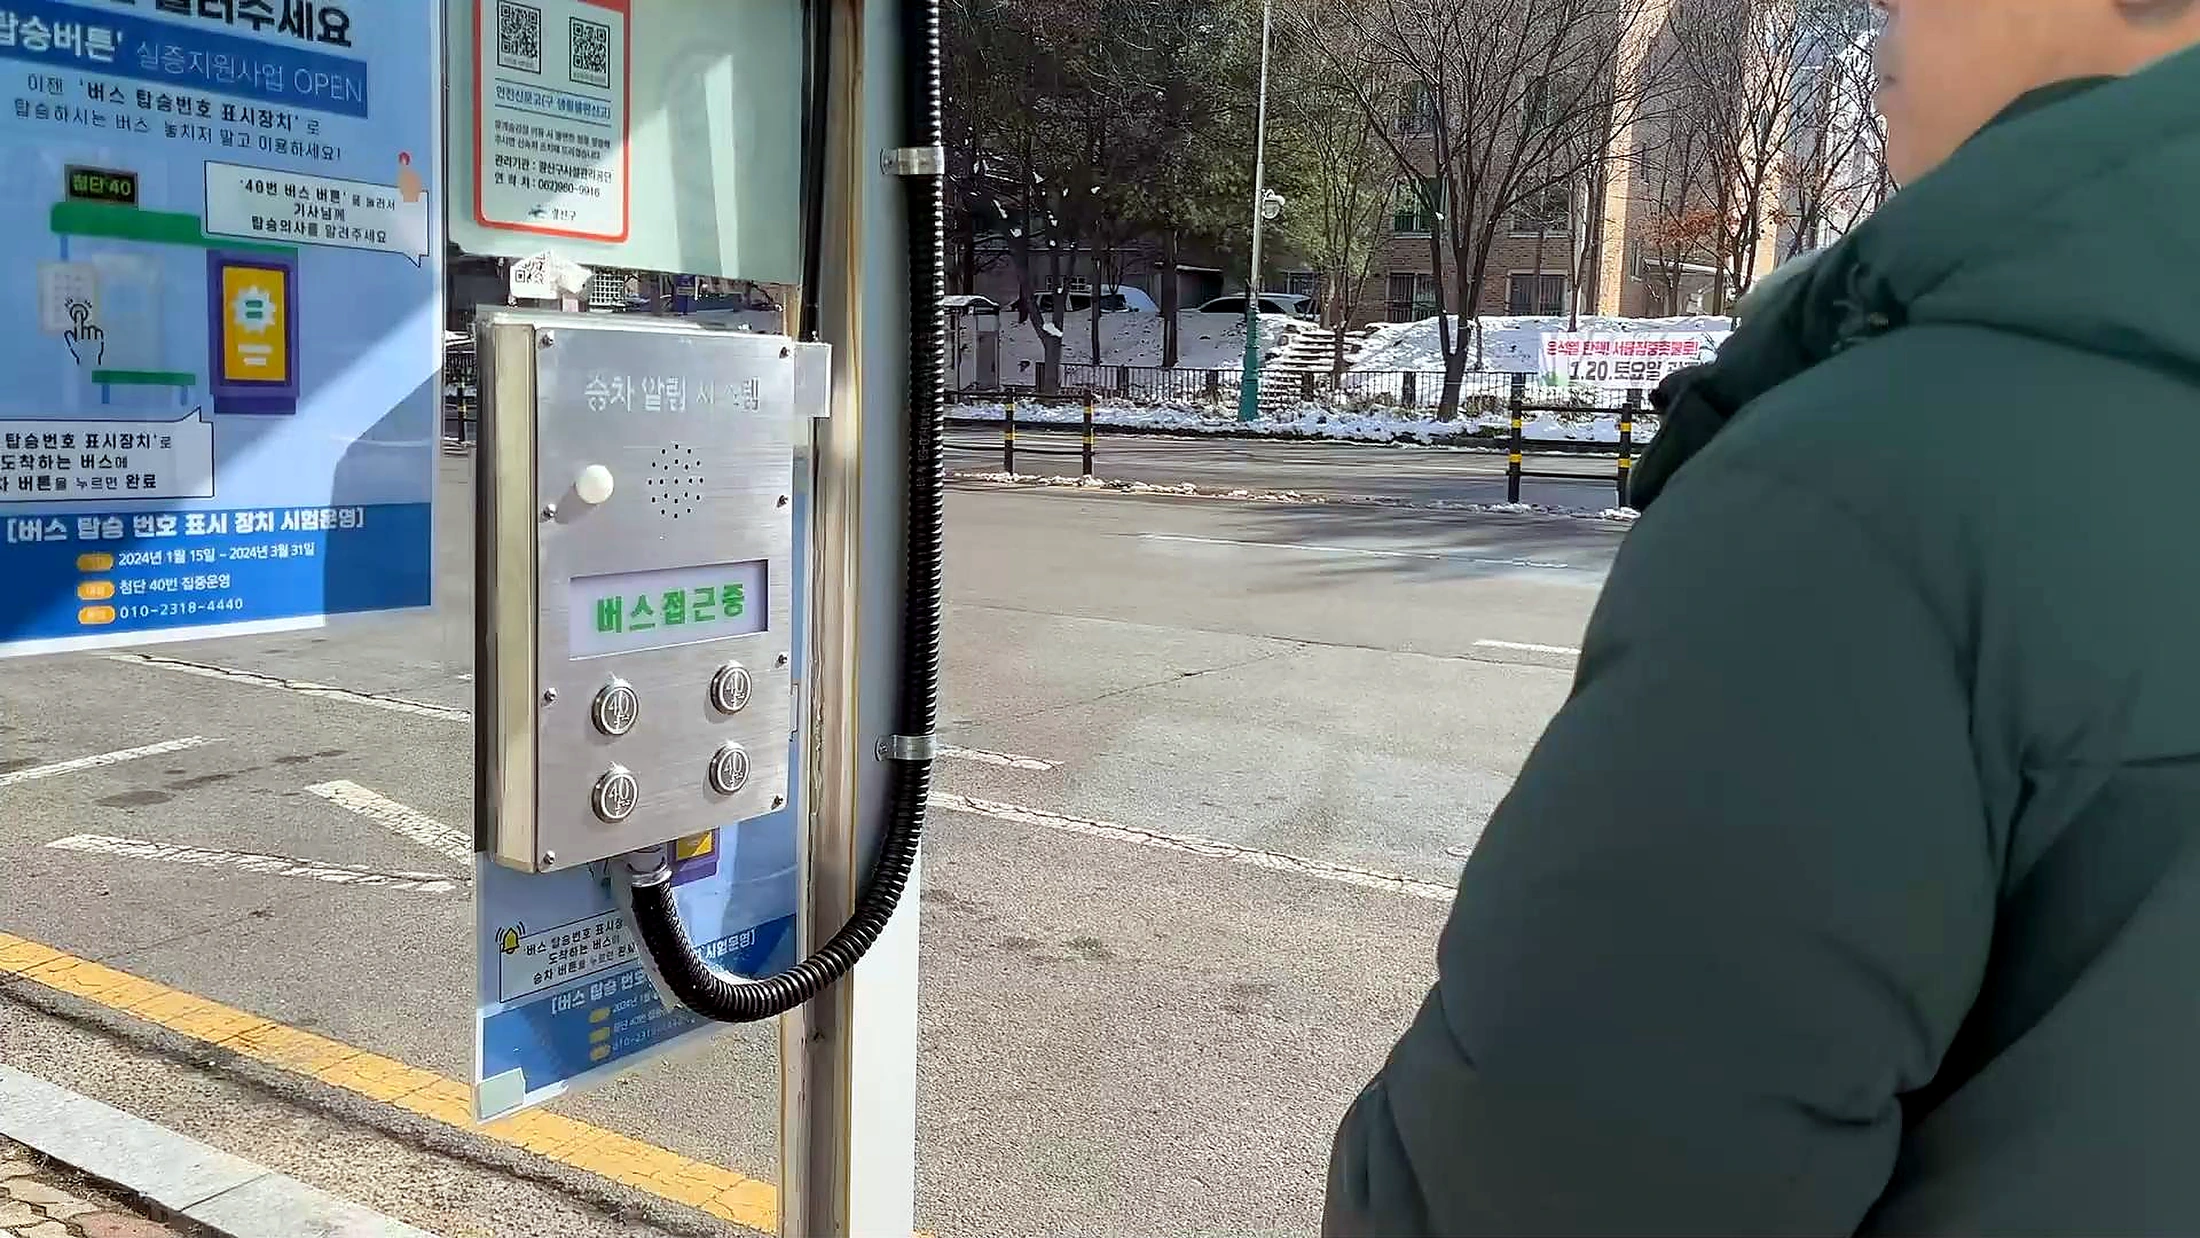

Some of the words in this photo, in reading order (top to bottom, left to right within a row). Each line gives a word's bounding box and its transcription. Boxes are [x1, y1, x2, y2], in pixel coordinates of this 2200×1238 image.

[137, 41, 284, 93] 실증지원사업
[294, 68, 362, 102] OPEN
[28, 73, 65, 96] 이젠
[136, 89, 211, 119] 탑승번호
[306, 119, 321, 136] 로
[15, 98, 106, 127] 탑승하시는
[115, 113, 149, 134] 버스
[220, 128, 251, 148] 말고
[258, 135, 341, 161] 이용하세요!
[109, 179, 132, 196] 40
[284, 183, 310, 201] 버스
[293, 202, 346, 222] 기사님께
[251, 215, 318, 238] 탑승의사를
[325, 223, 387, 244] 알려주세요
[584, 373, 635, 412] 승차
[641, 375, 687, 412] 알림
[5, 432, 76, 450] 탑승번호
[1, 453, 71, 471] 도착하는
[81, 454, 128, 470] 버스에
[18, 474, 67, 492] 버튼을
[76, 476, 118, 490] 누르면
[126, 473, 157, 490] 완료
[77, 515, 124, 540] 탑승
[133, 513, 178, 538] 번호
[185, 512, 228, 536] 표시
[235, 510, 275, 534] 장치
[118, 550, 162, 566] 2024년
[166, 549, 186, 564] 1월
[190, 548, 216, 563] 15일
[229, 544, 268, 561] 2024년
[270, 543, 289, 559] 3월
[291, 542, 315, 557] 31일
[119, 578, 147, 595] 첨단
[149, 577, 178, 592] 40번
[181, 573, 231, 591] 집중운영
[119, 598, 244, 619] 010-2318-4440
[596, 583, 746, 634] 버스접근중
